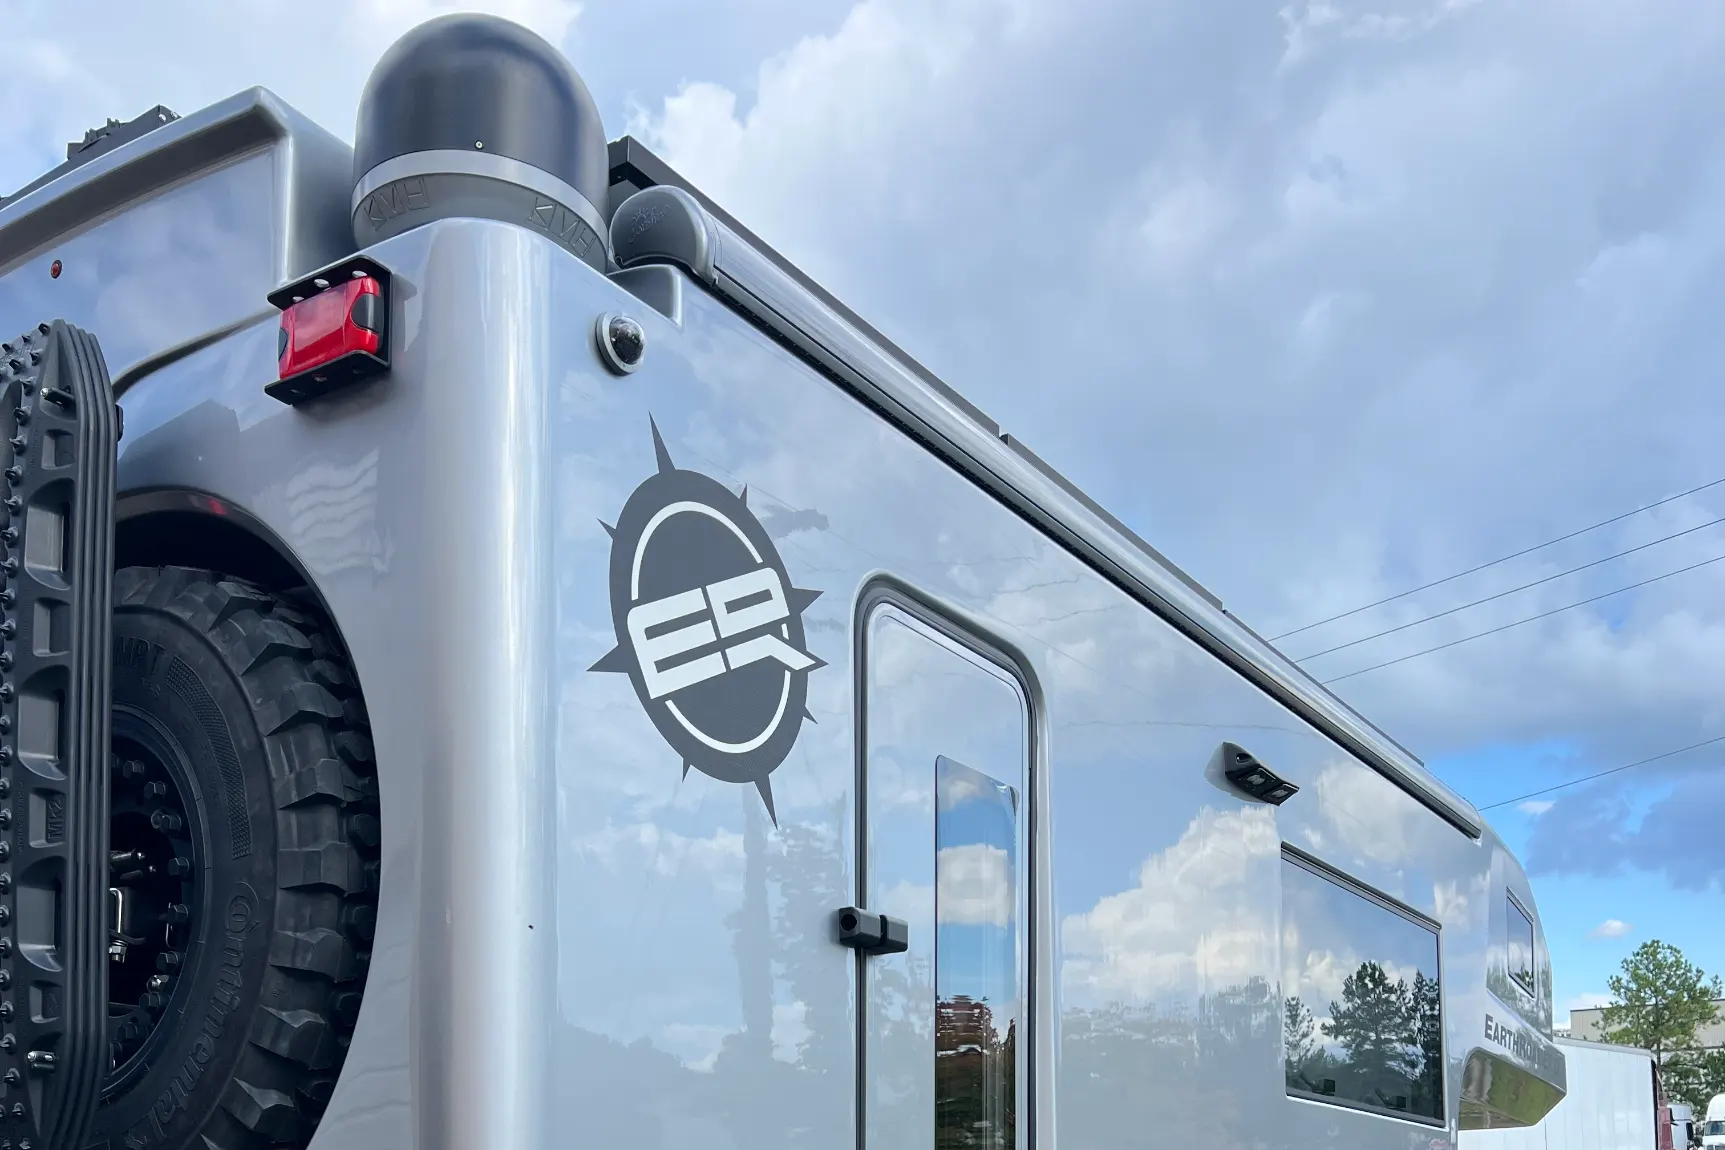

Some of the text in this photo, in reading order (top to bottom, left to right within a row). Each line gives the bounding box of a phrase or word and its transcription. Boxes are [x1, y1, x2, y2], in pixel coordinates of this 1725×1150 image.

[363, 177, 430, 231] KVH
[527, 196, 597, 258] KVH
[626, 566, 817, 701] ER
[150, 880, 260, 1144] Continental
